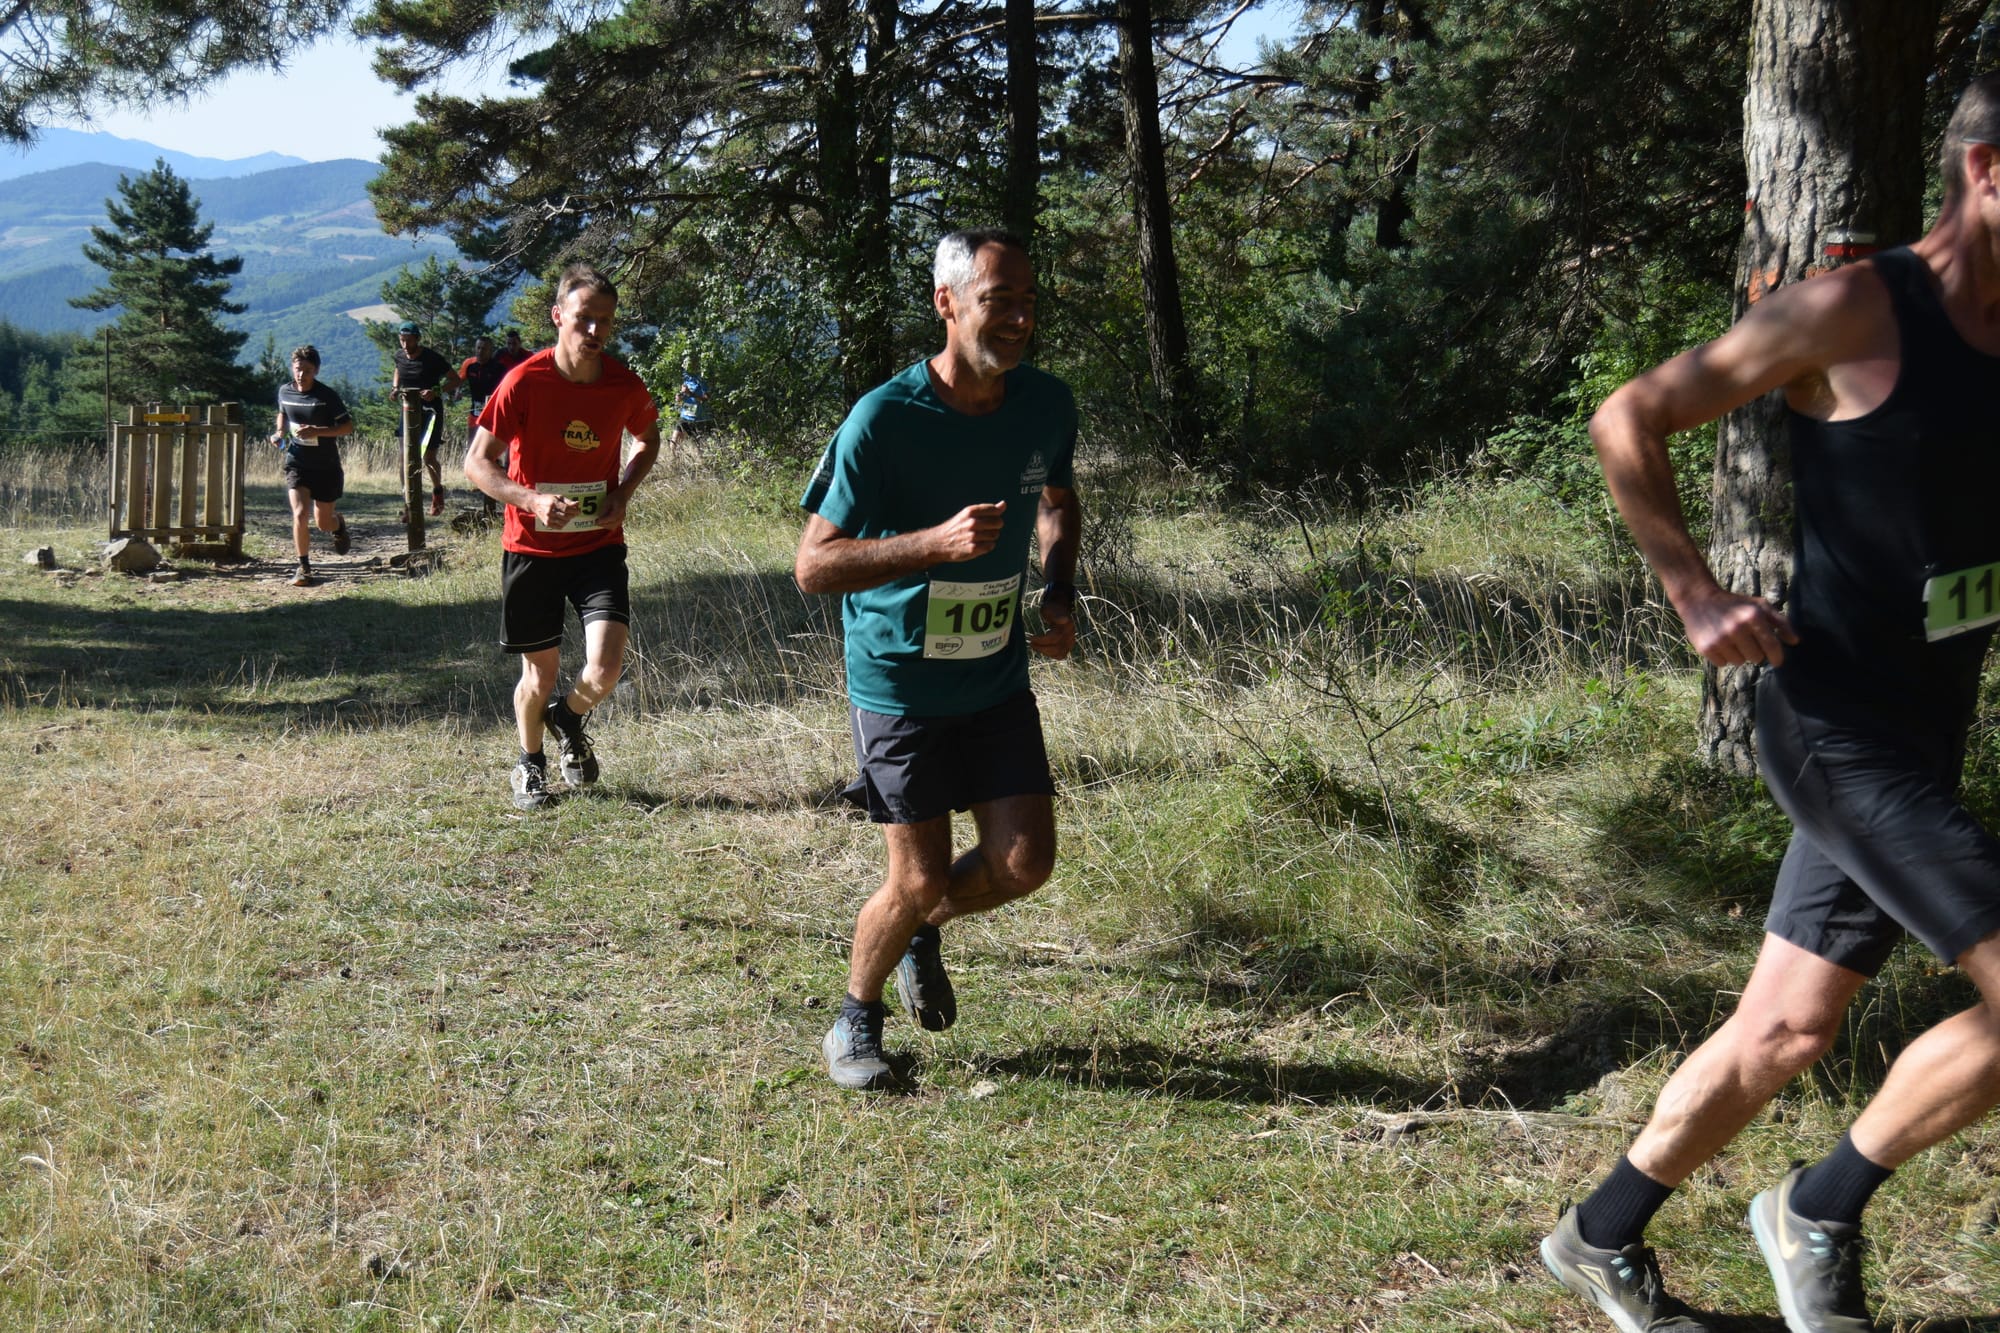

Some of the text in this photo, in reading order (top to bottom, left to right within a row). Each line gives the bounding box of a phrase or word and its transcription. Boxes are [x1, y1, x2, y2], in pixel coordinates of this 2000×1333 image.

[572, 496, 597, 515] 5
[1947, 568, 2000, 621] 11
[945, 597, 1010, 633] 105
